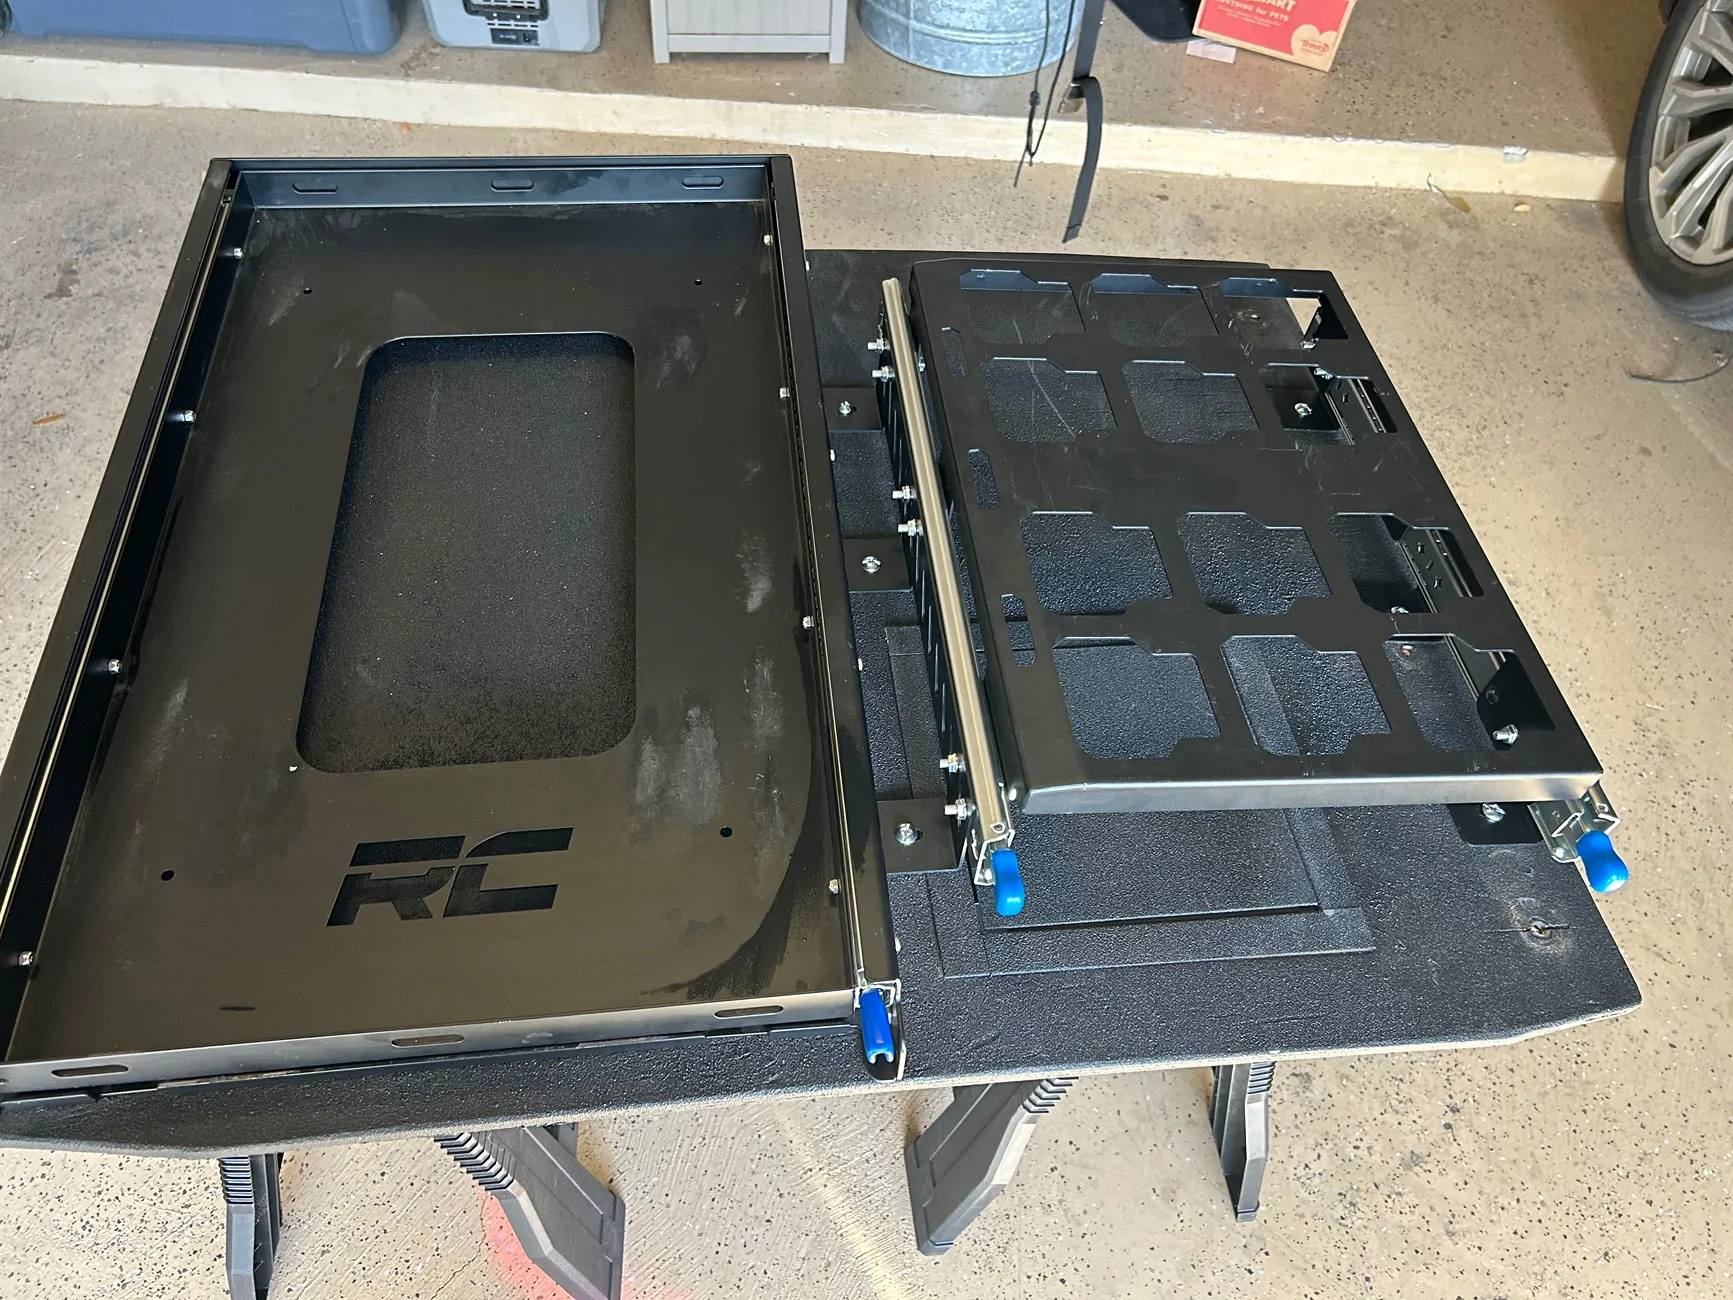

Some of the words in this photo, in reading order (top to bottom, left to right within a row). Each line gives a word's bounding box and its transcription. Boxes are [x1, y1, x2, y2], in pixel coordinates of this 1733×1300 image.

[1255, 7, 1268, 15] for
[1269, 11, 1289, 22] PETS
[325, 827, 574, 926] RC
